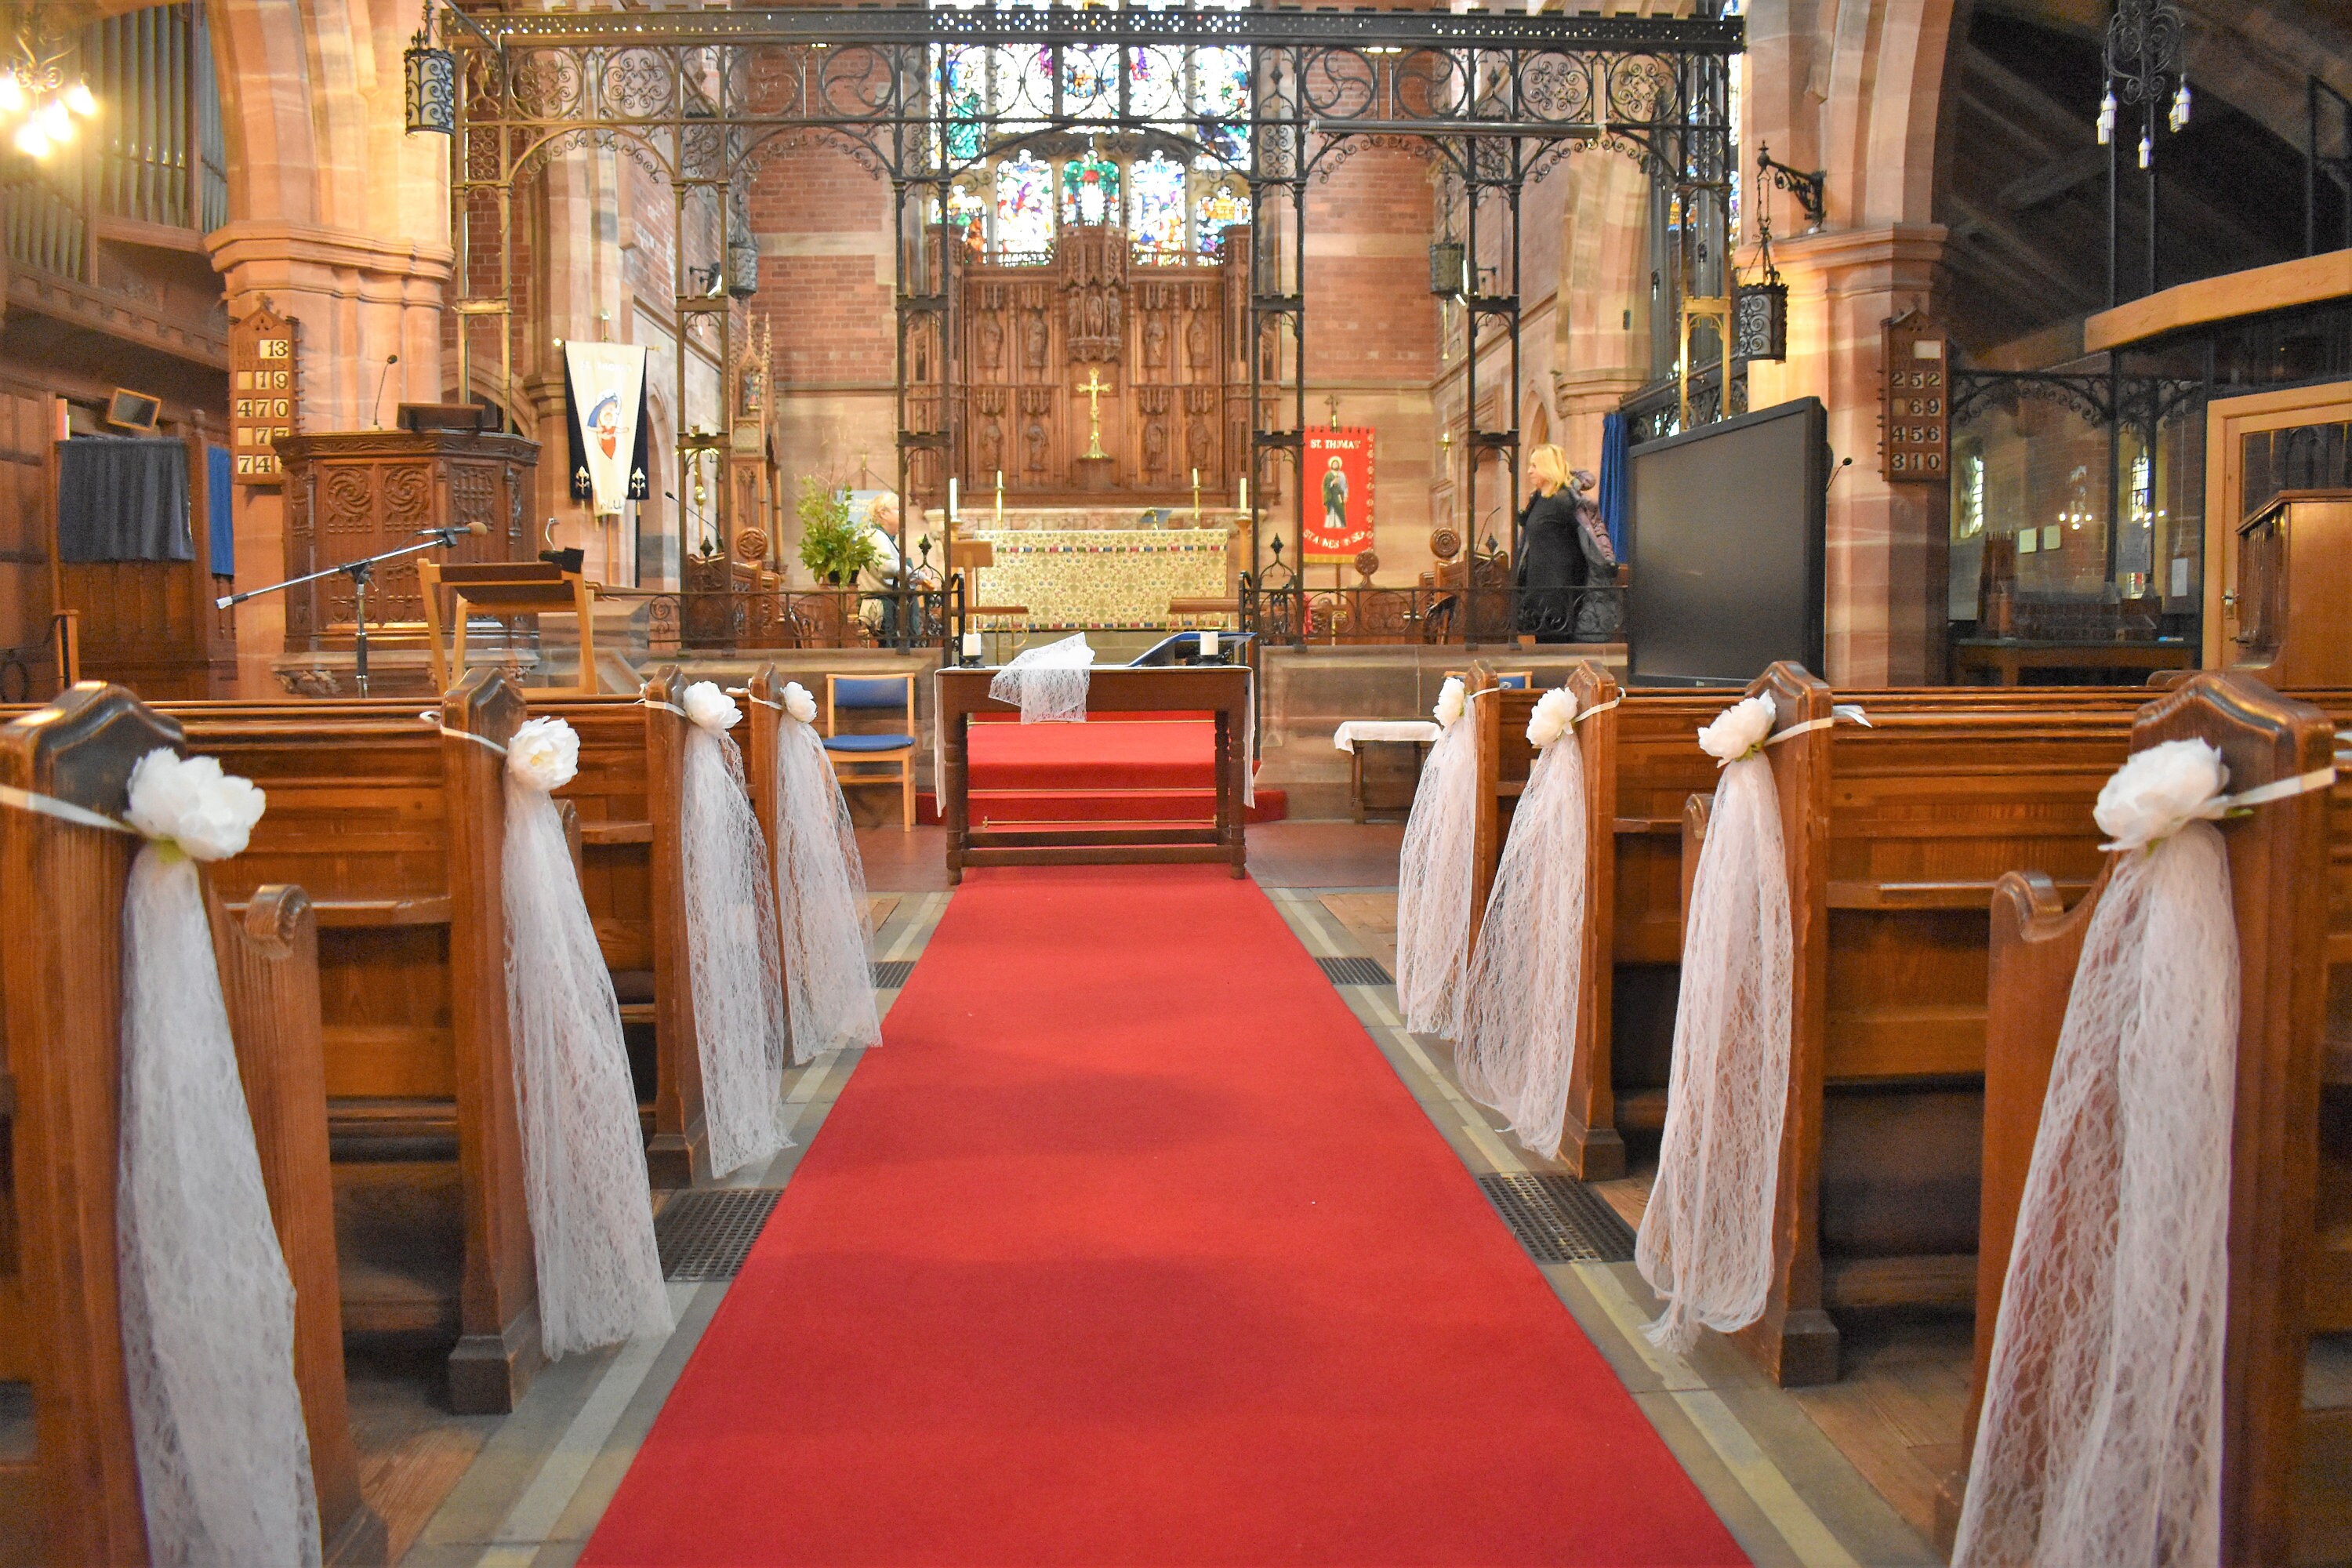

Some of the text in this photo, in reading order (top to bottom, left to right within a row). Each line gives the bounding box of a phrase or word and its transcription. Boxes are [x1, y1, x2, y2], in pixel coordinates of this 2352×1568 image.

[267, 340, 288, 357] 13
[237, 360, 286, 369] HYMNS
[260, 371, 289, 390] 19
[1892, 372, 1940, 388] 252
[237, 401, 289, 418] 470
[1910, 398, 1940, 415] 69
[1892, 426, 1940, 442] 456
[1891, 453, 1940, 470] 310
